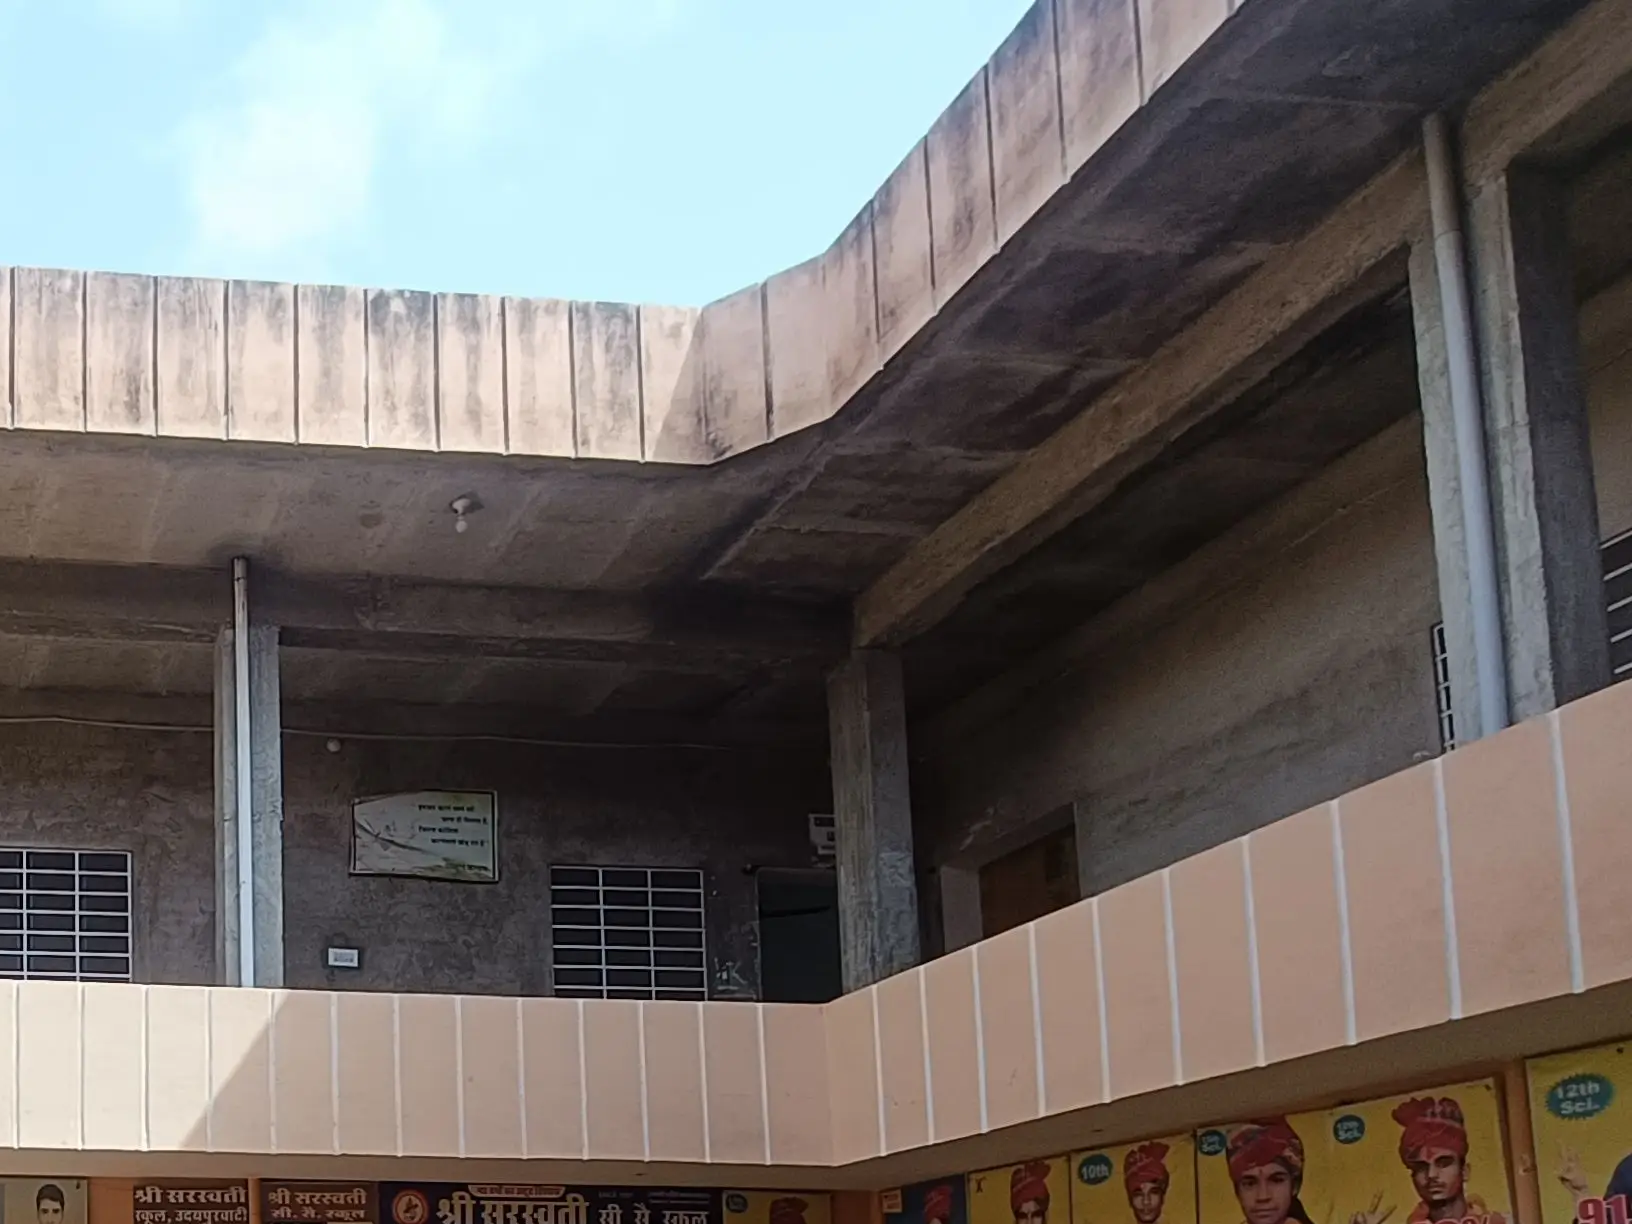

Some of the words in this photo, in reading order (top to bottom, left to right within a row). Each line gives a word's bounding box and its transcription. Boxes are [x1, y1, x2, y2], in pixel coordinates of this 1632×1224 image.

[1082, 1162, 1109, 1180] 10th
[134, 1186, 163, 1203] श्री
[167, 1186, 247, 1204] सरस्वती
[268, 1188, 290, 1205] श्री
[293, 1188, 367, 1205] सरस्वती
[324, 1209, 365, 1221] स्कूल
